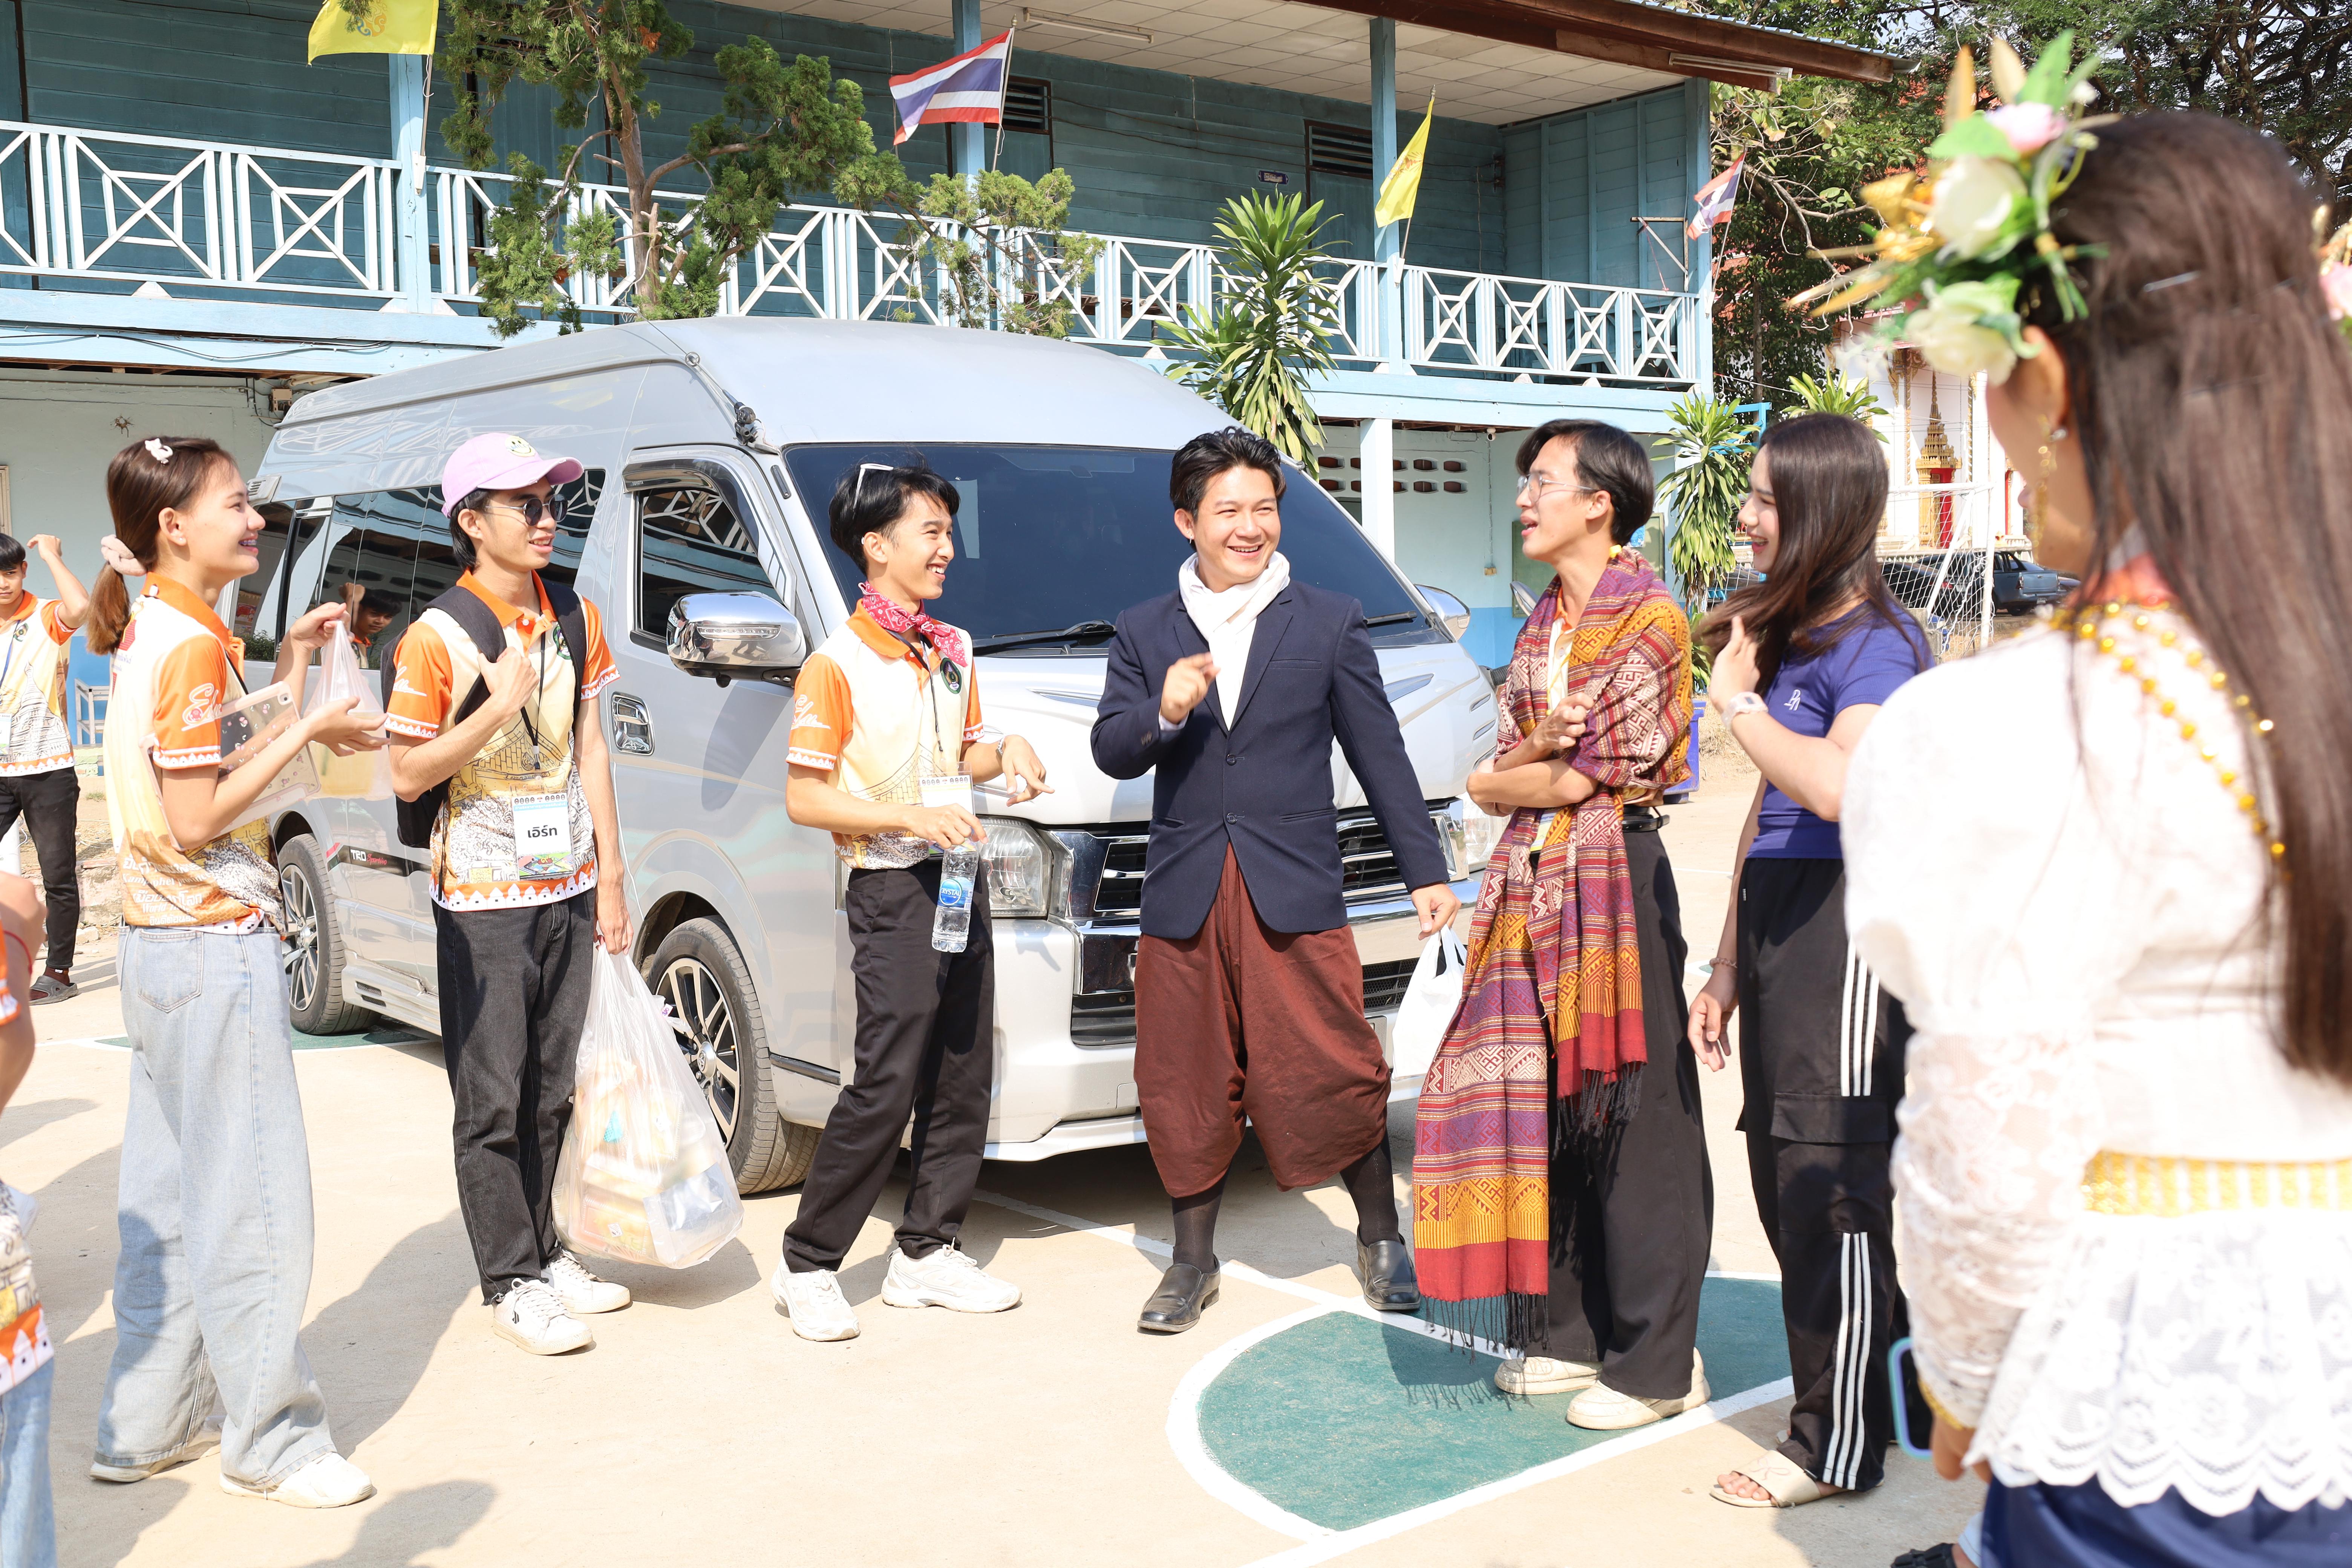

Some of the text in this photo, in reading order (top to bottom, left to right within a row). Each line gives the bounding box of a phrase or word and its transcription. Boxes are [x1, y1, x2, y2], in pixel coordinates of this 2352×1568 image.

[528, 825, 557, 838] เอิร์ท
[350, 849, 366, 862] TRD
[941, 888, 960, 896] CRYSTAL
